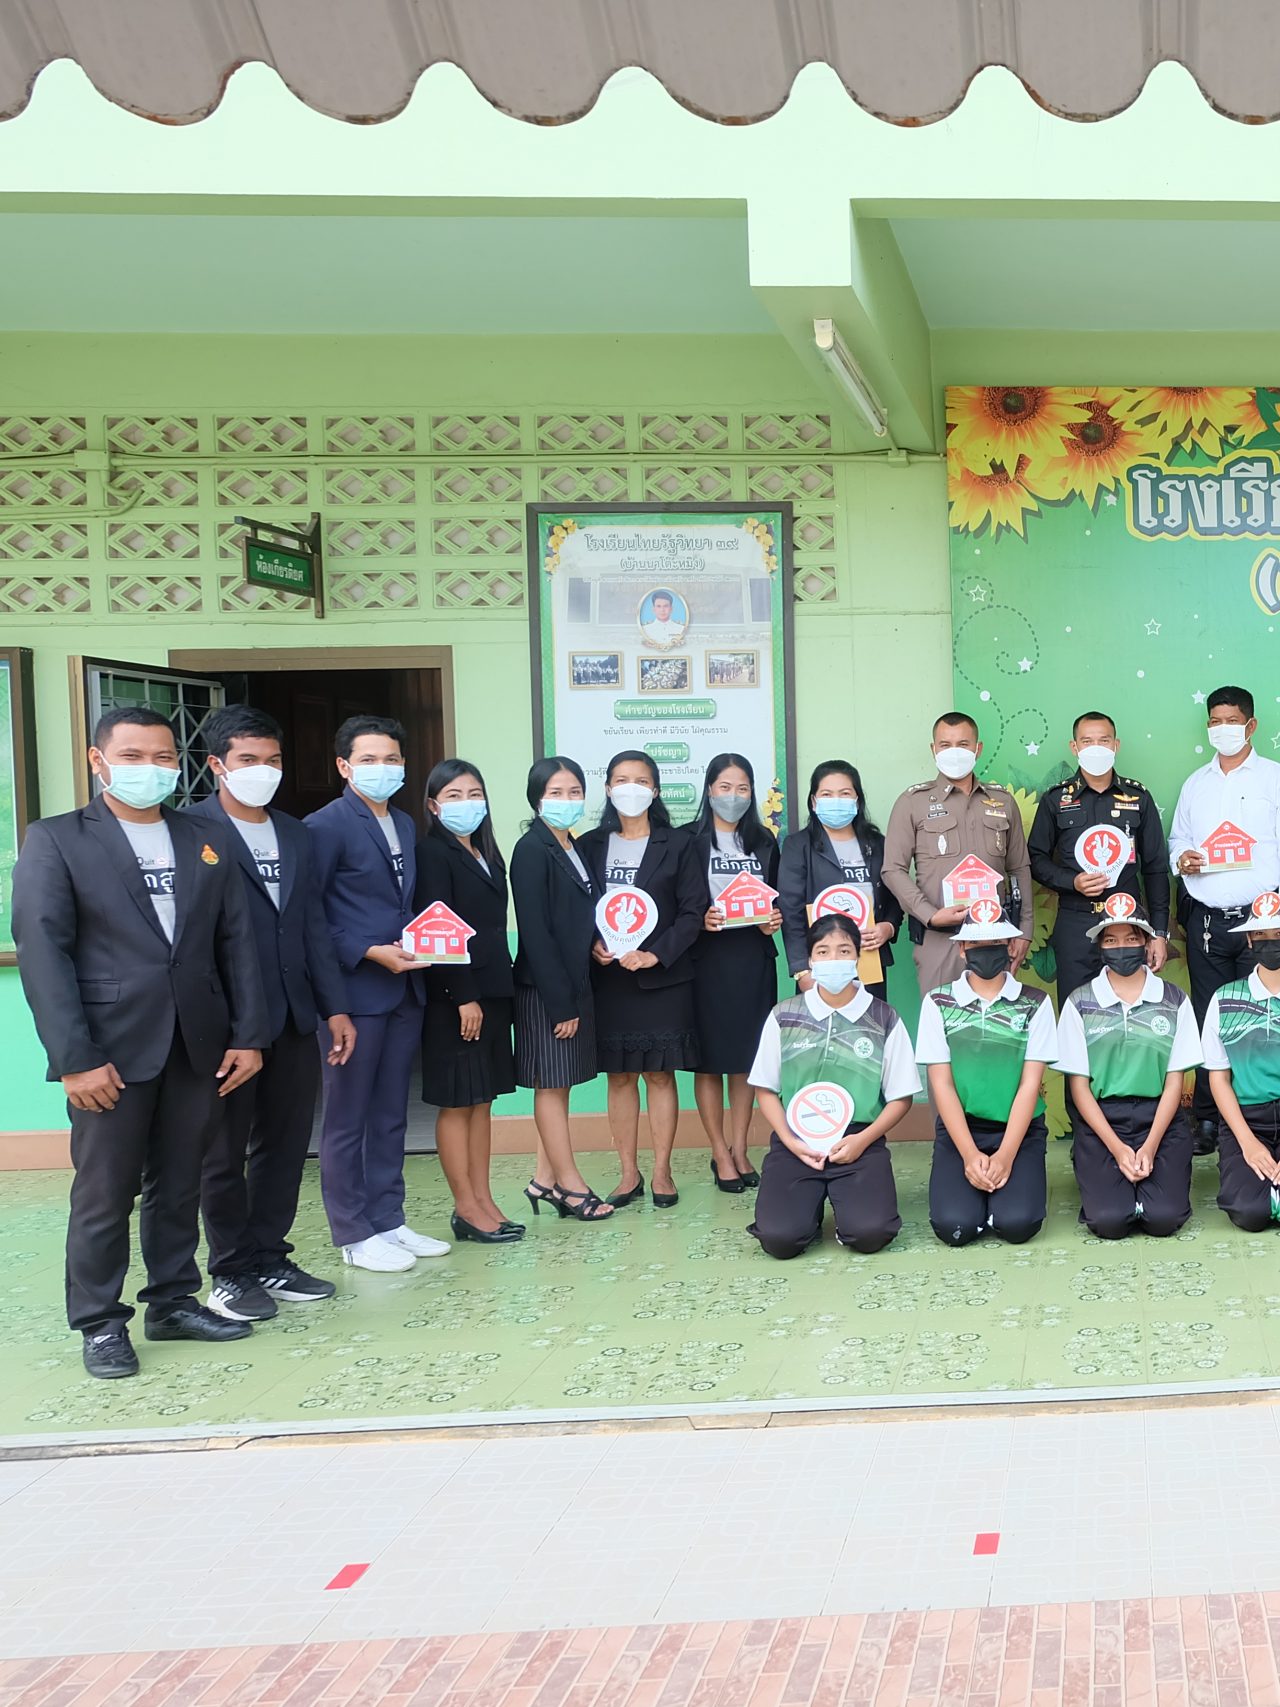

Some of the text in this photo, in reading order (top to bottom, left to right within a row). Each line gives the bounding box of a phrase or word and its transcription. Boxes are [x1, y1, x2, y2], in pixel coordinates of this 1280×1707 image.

[584, 533, 739, 555] โรงเรียนไทยรัฐวิทยา ๓๙
